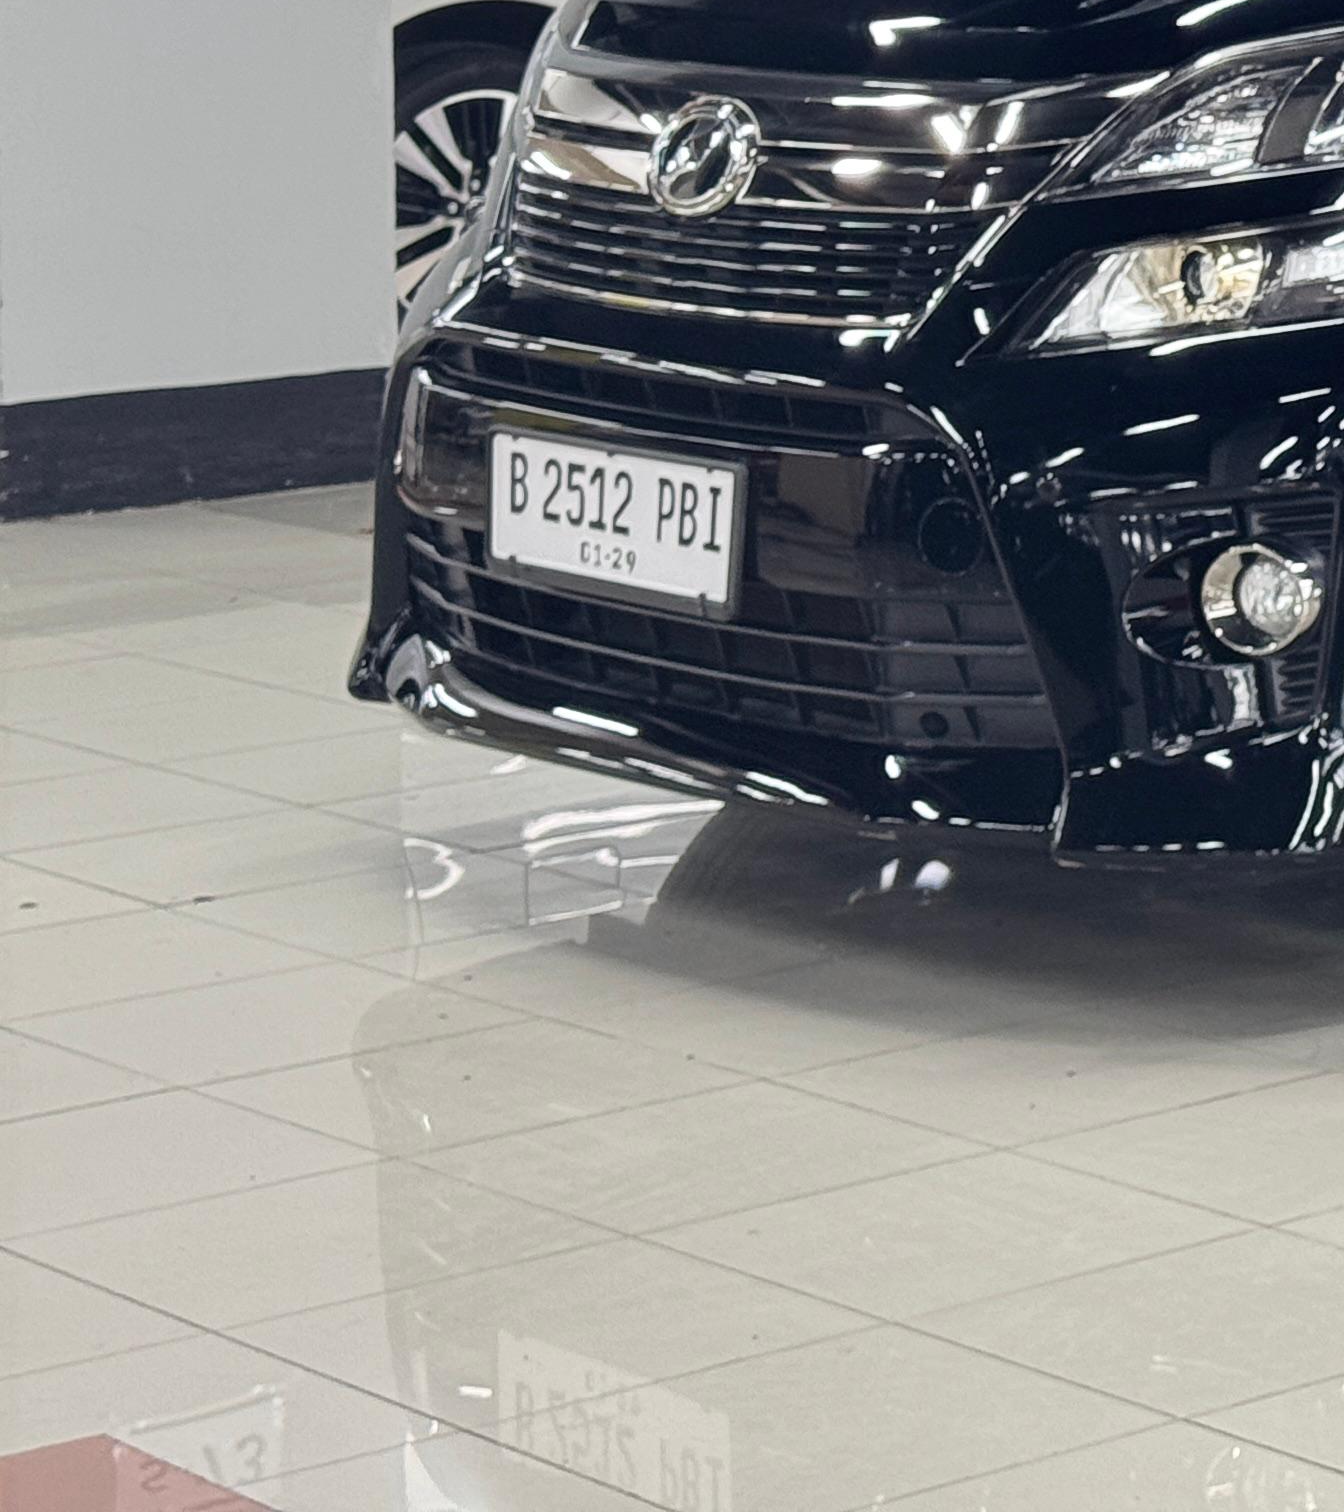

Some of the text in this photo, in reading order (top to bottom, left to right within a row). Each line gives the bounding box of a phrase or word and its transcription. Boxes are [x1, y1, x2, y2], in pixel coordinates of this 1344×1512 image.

[510, 452, 721, 553] B 2512 PBI
